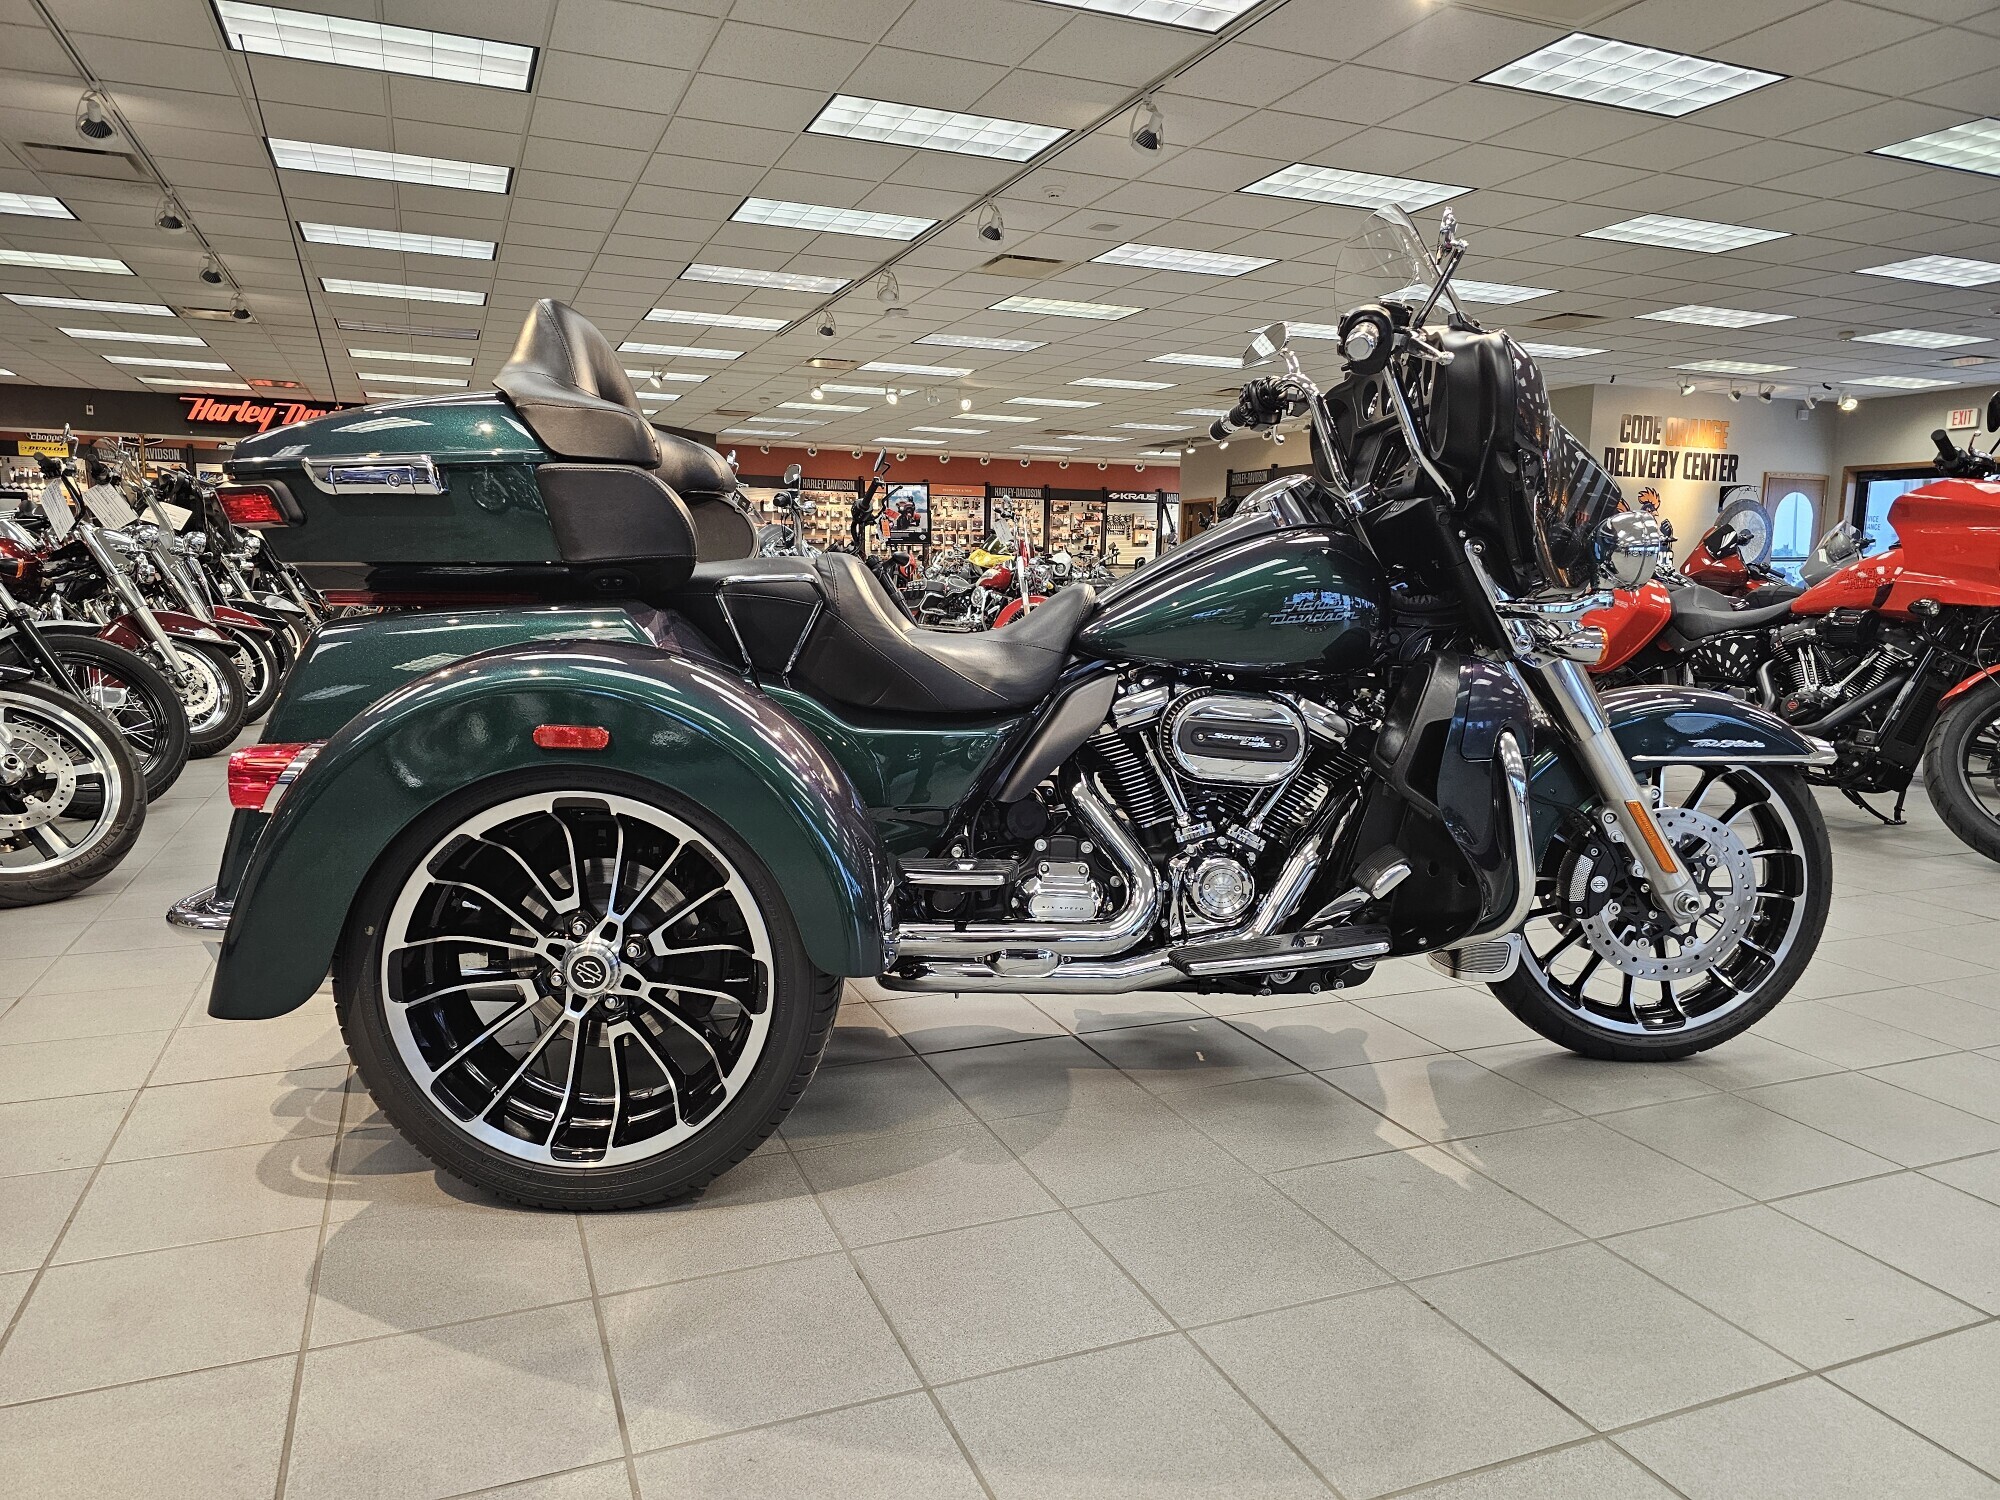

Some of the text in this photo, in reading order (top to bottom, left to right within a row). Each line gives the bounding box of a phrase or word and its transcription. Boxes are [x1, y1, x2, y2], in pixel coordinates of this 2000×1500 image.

[1952, 410, 1973, 426] EXIT
[1620, 414, 1730, 449] CODE ORANGE
[1604, 447, 1739, 482] DELIVERY CENTER
[802, 479, 855, 490] HARLEY-DAVIDSON
[994, 487, 1042, 498] HARLEY-DAVIDSON
[1121, 492, 1157, 501] KRAUS
[1269, 611, 1361, 625] Davidson
[1240, 739, 1272, 748] Eagle
[60, 834, 116, 873] MICHELIN
